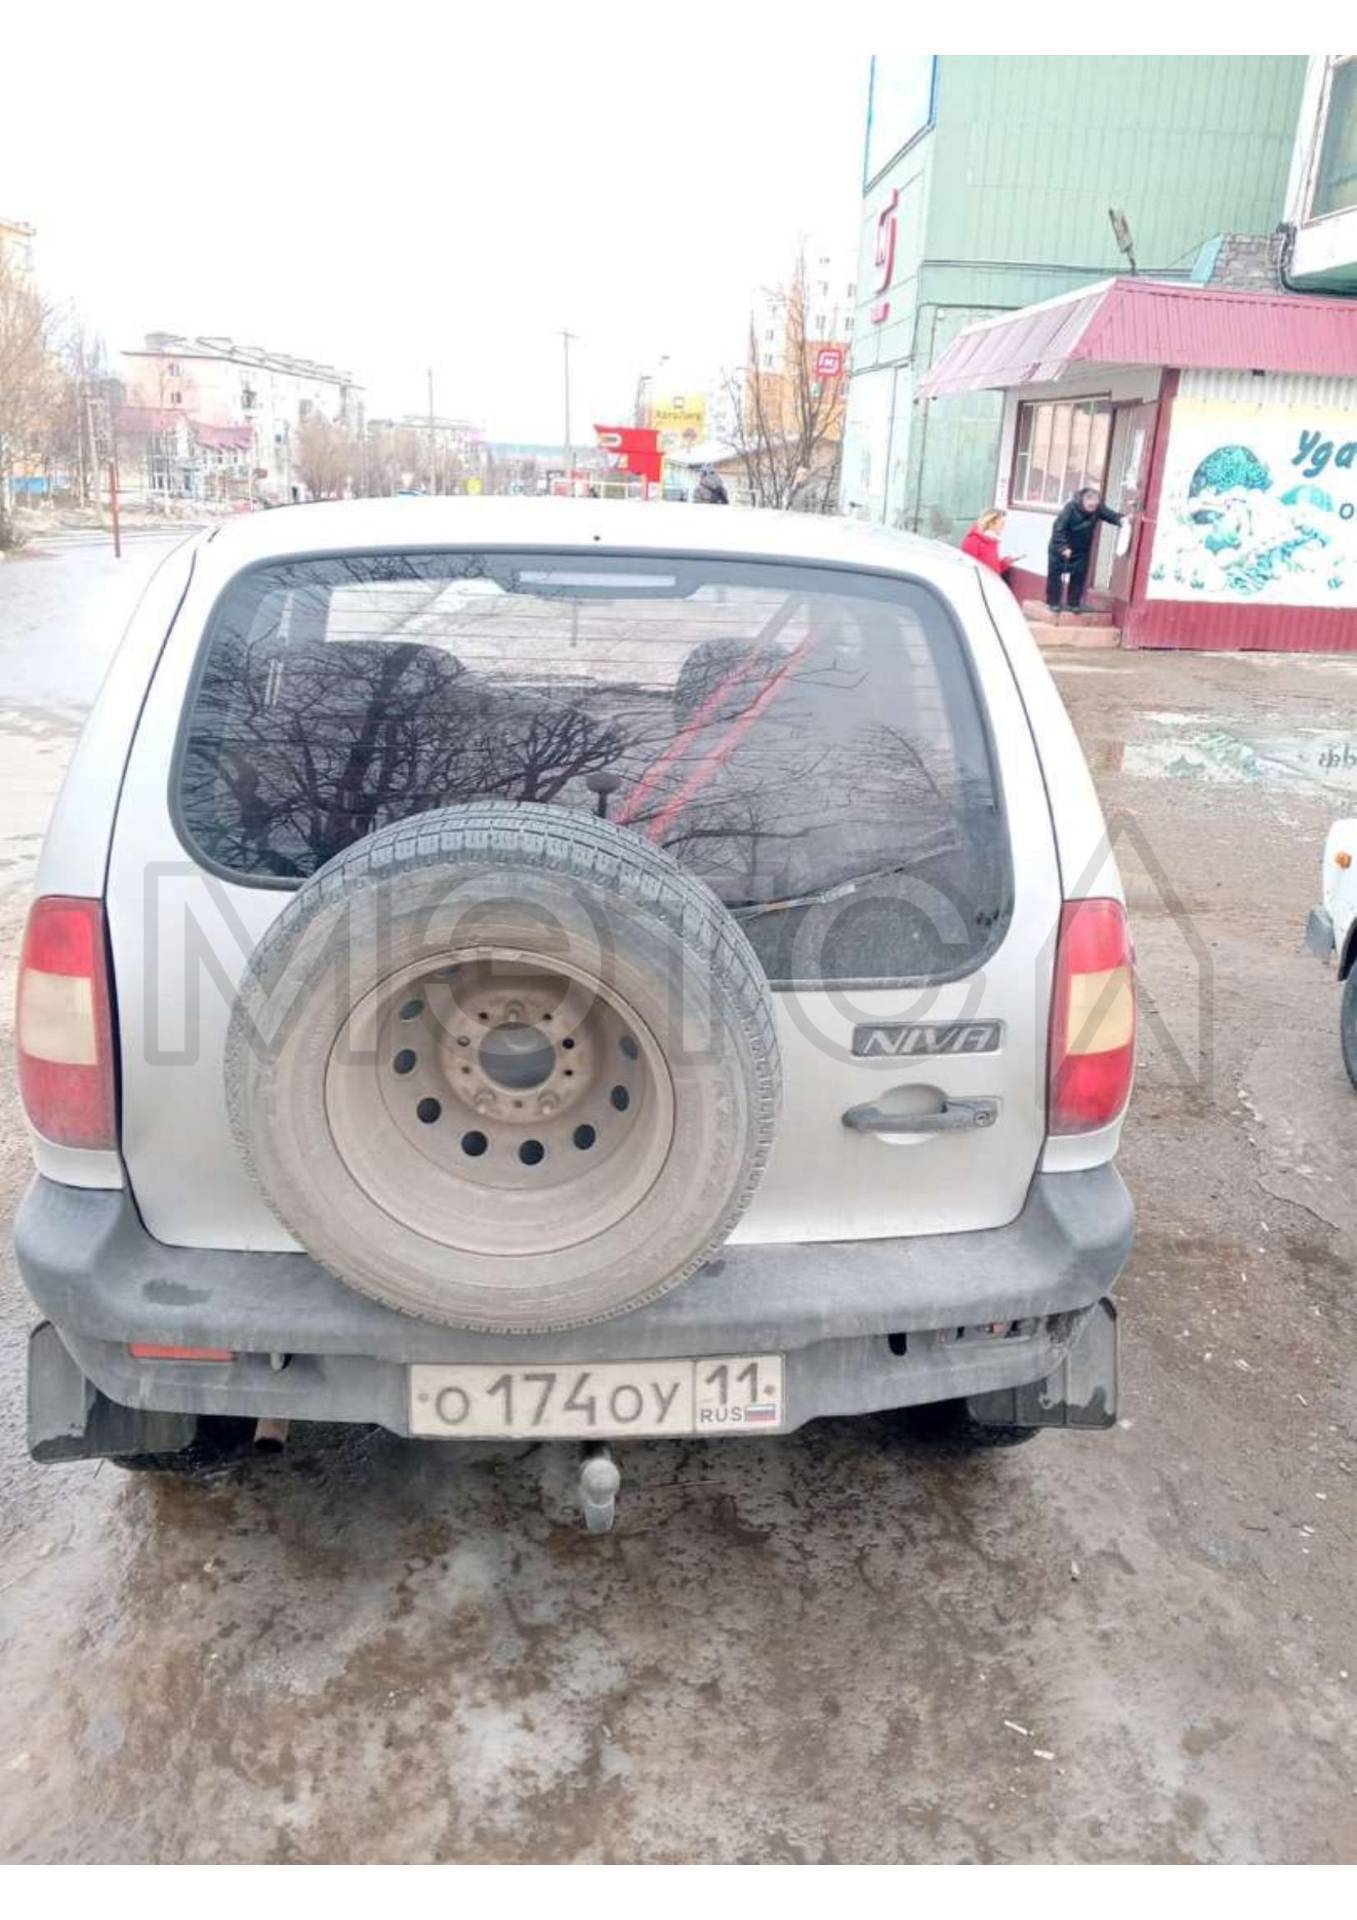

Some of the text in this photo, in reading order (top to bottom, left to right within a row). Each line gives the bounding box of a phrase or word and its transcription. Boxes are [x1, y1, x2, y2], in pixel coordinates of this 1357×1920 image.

[862, 1027, 995, 1054] NIVA
[704, 1361, 759, 1404] 11
[699, 1405, 743, 1423] RUS
